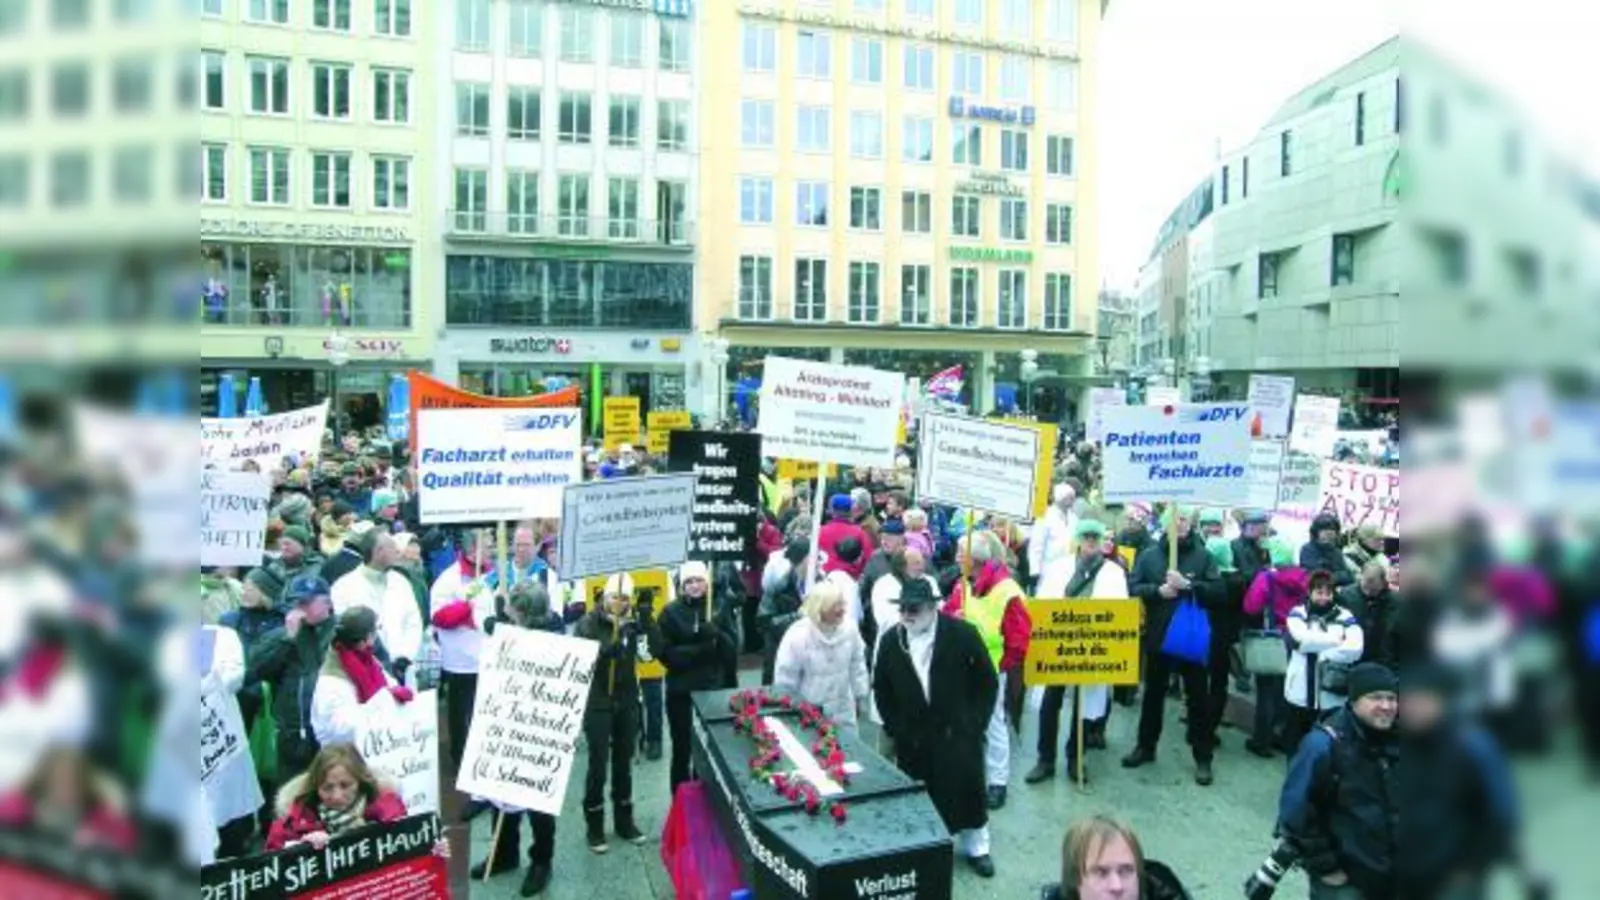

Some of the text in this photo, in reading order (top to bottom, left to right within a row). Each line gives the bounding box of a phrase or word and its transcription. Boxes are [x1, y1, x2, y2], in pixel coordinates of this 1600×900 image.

[490, 336, 557, 354] swatch
[536, 414, 577, 430] DFV
[1210, 407, 1249, 422] DFV
[1105, 429, 1202, 448] Patienten
[421, 446, 574, 464] Facharzt erhalten
[704, 443, 729, 458] Wir
[422, 470, 570, 490] Qualität erhalten
[1148, 463, 1245, 481] Fachärzte
[1329, 465, 1400, 497] STOP
[698, 536, 745, 552] Grabe!
[1094, 611, 1115, 623] mit
[1031, 627, 1138, 643] eistungskürzungen
[1056, 643, 1086, 657] durch
[1035, 659, 1129, 674] Krankenkassen!
[854, 868, 917, 897] Verlust
